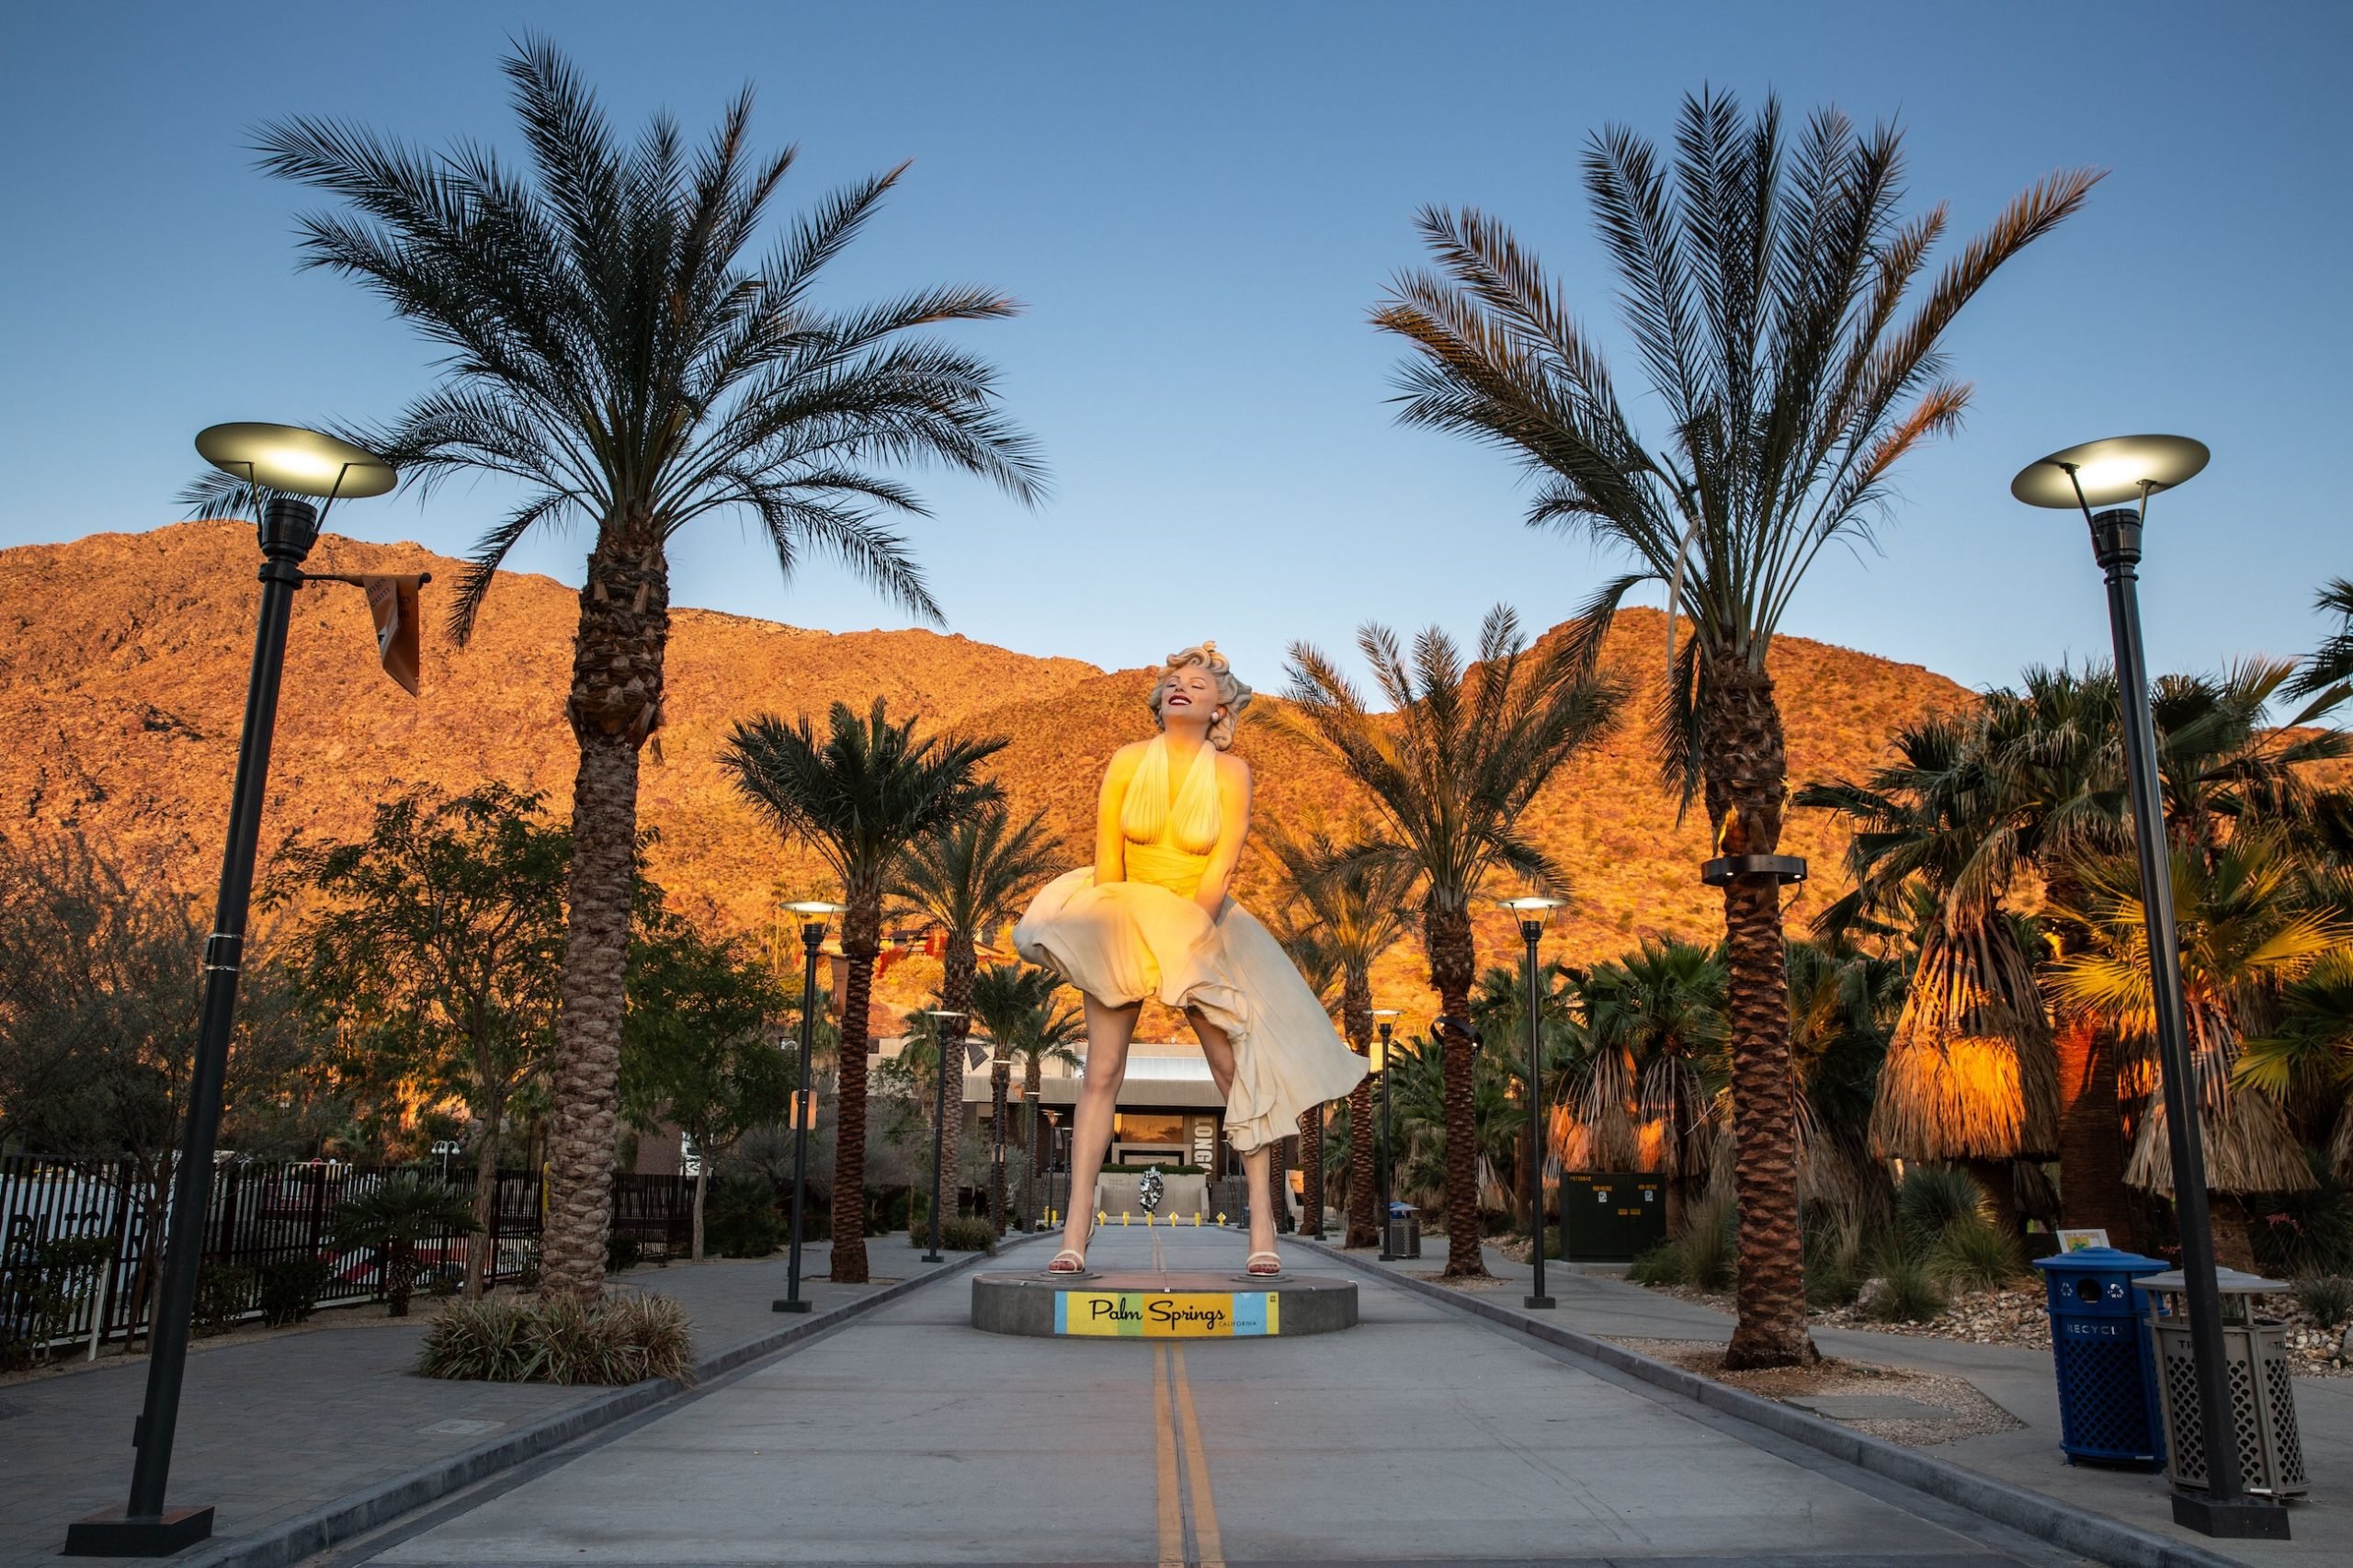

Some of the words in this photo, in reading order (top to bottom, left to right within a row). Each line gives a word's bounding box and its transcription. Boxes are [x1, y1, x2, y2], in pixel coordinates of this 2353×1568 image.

[1088, 1297, 1142, 1321] Palm
[1148, 1301, 1225, 1330] Springs
[2066, 1324, 2121, 1335] RECYCL
